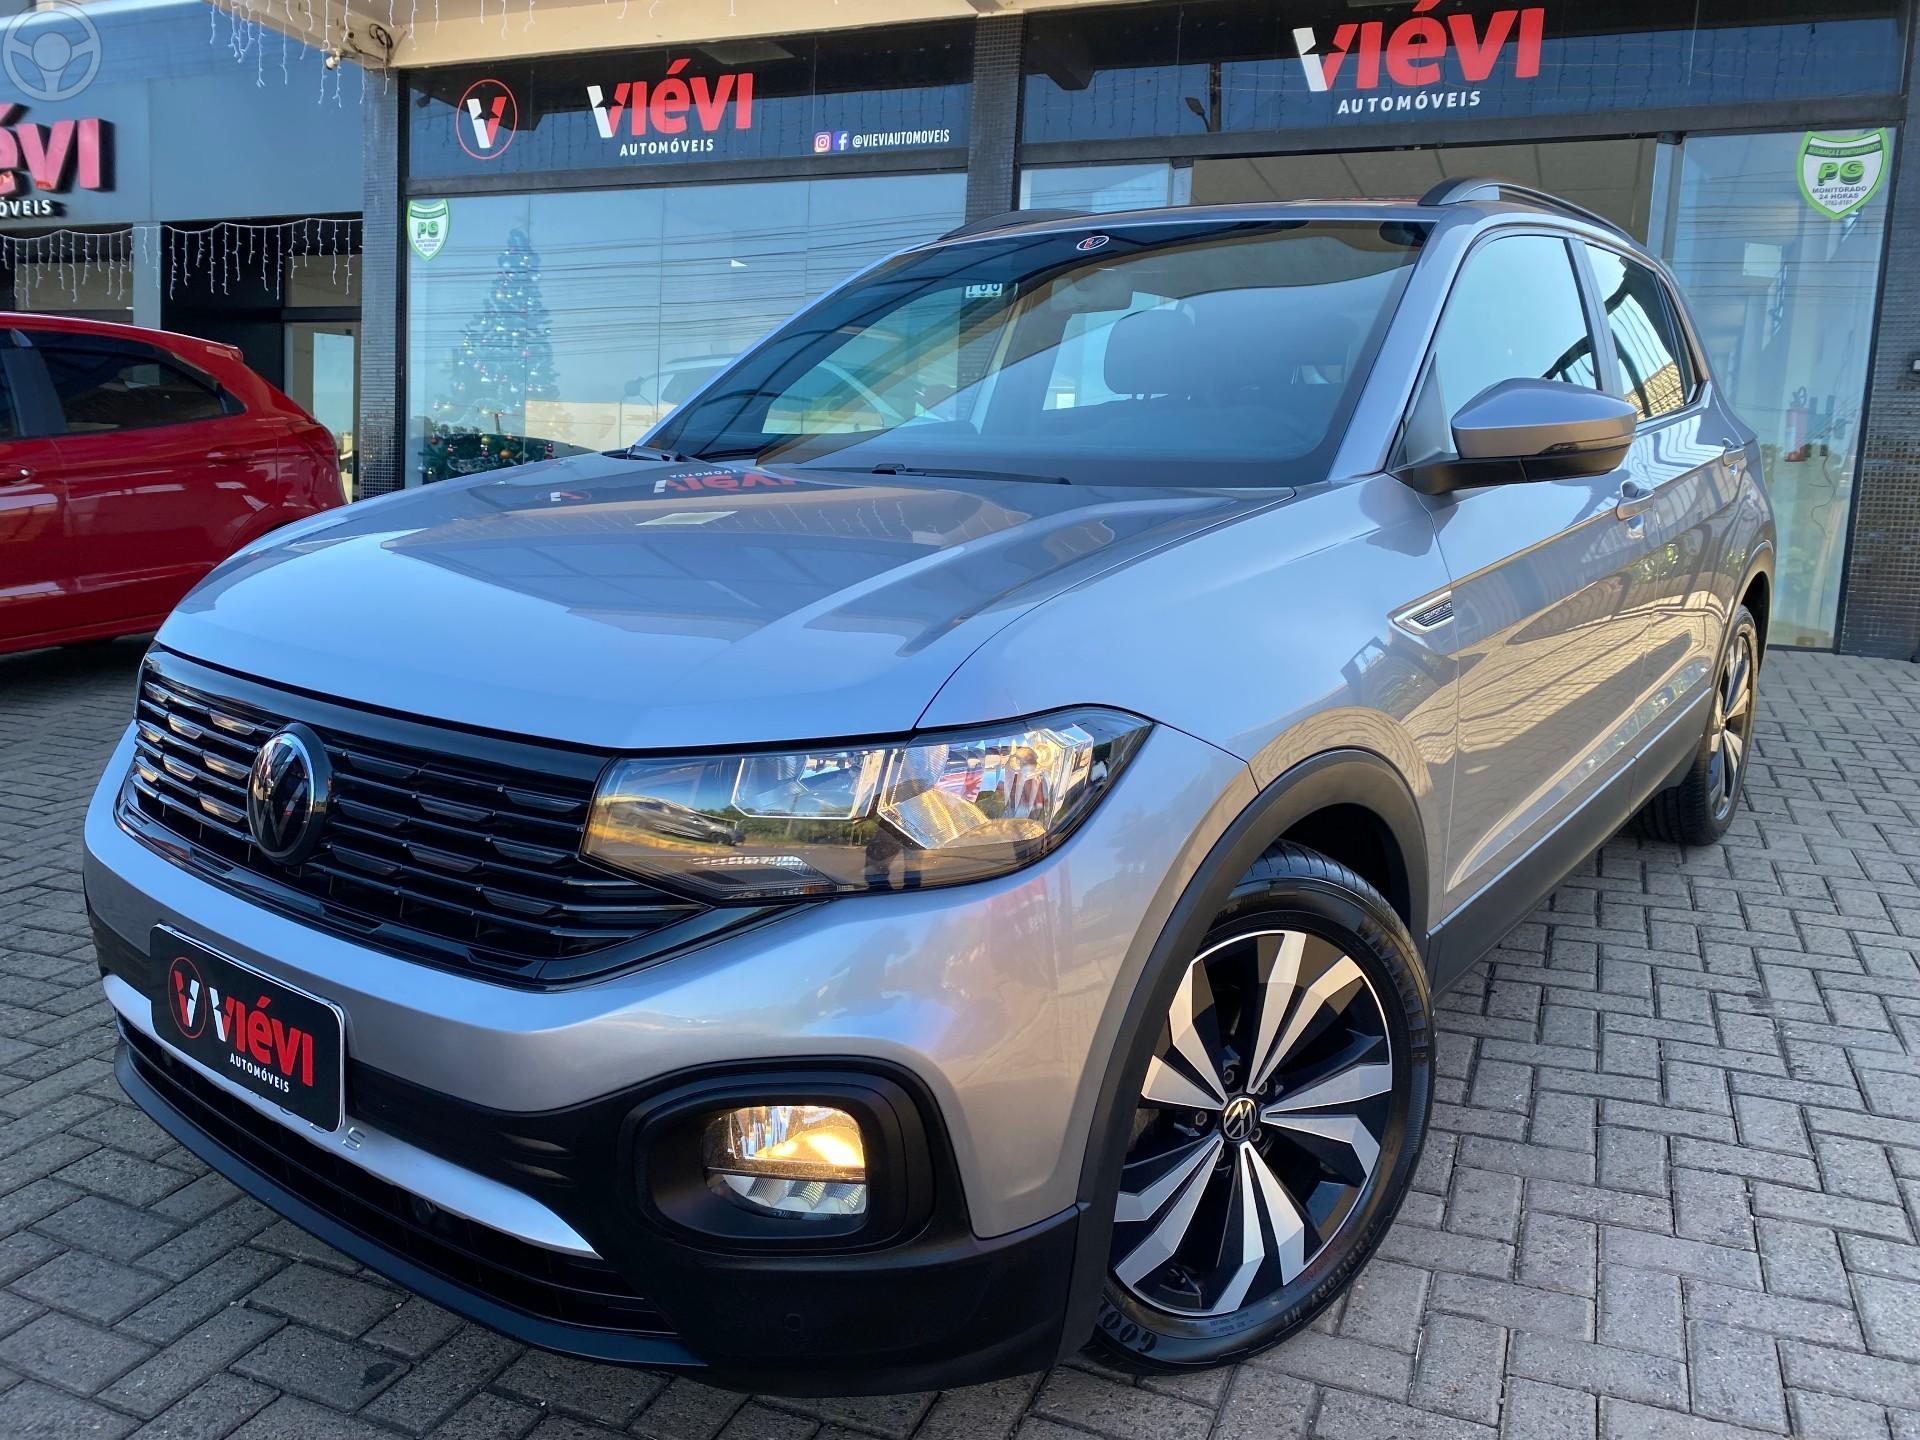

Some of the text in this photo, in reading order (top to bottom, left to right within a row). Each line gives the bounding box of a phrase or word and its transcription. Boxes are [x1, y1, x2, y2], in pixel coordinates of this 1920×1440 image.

[1337, 90, 1481, 115] AUTOMÓVEIS
[620, 138, 714, 157] AUTOMÓVEIS
[852, 129, 950, 148] @VIEVIAUTOMOVEIS
[229, 1052, 290, 1094] AUTOMÓVEIS
